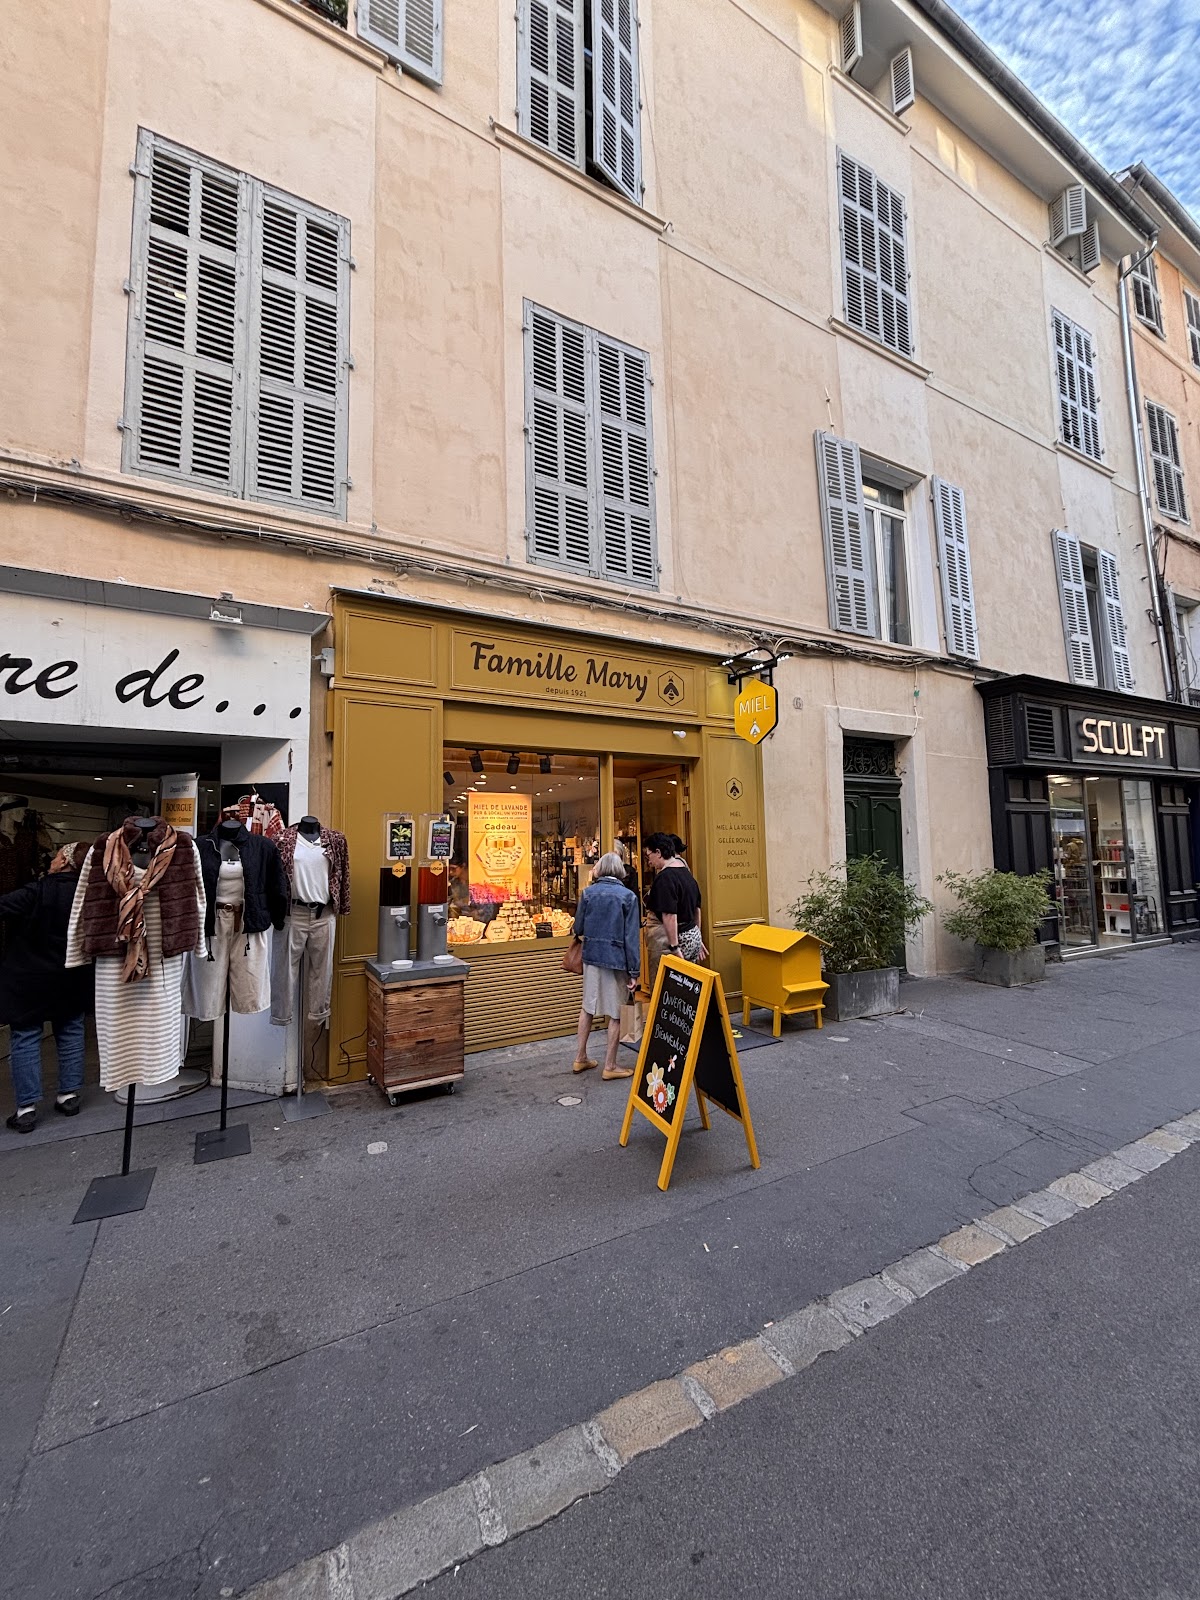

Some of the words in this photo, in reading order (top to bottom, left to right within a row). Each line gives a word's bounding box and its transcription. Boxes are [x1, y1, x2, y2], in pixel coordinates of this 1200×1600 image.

[470, 641, 578, 683] Famille
[586, 658, 648, 703] Mary
[545, 686, 569, 696] depuis
[571, 689, 587, 698] 1921
[739, 695, 771, 717] MIEL
[1082, 718, 1166, 759] SCULPT
[165, 802, 193, 813] BOURGUE
[484, 823, 517, 831] Cadeau
[718, 836, 735, 844] GELÉE
[662, 990, 697, 1022] OUVERTURE
[660, 1008, 668, 1020] CE
